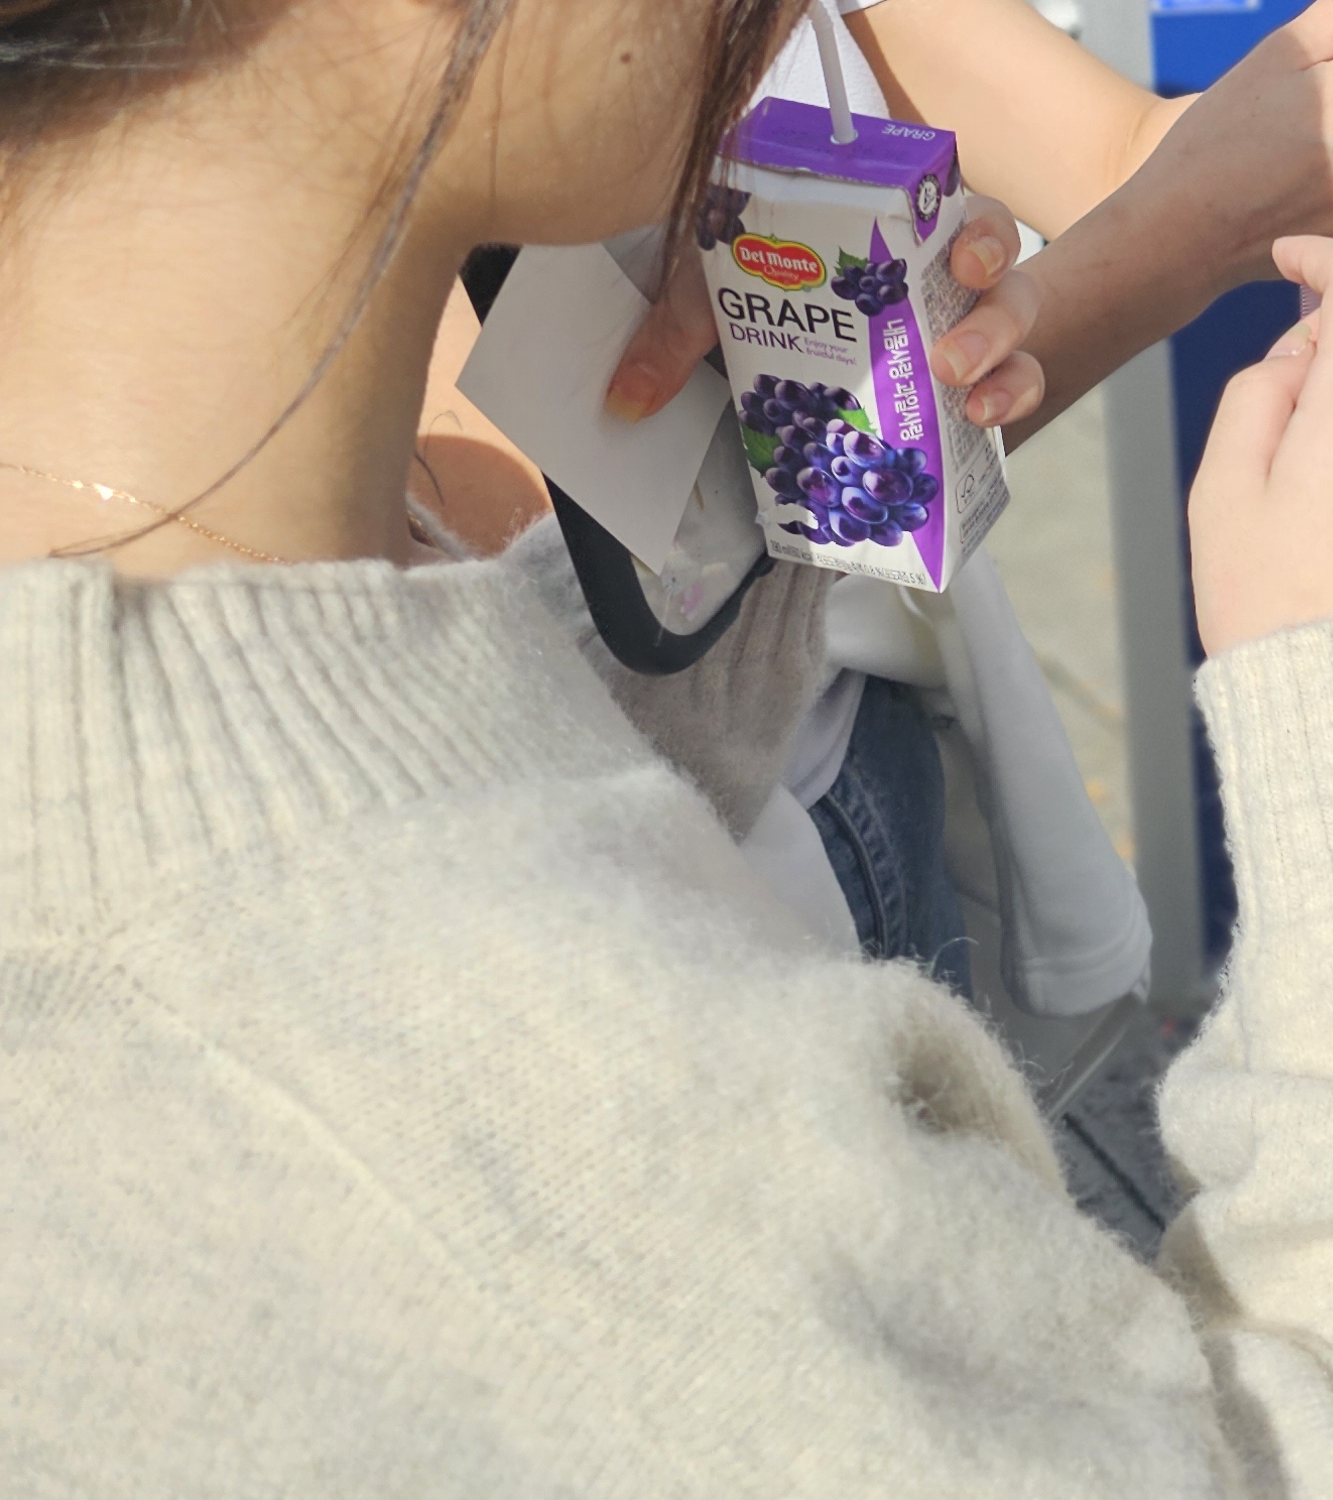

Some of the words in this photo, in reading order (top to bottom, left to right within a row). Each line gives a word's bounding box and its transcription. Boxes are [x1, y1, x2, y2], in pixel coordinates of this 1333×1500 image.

[882, 122, 936, 141] GRAPE
[739, 246, 765, 264] Del
[766, 251, 818, 273] Monte
[717, 287, 857, 343] GRAPE
[729, 322, 804, 353] DRINK
[804, 337, 828, 350] Enjoy
[883, 318, 914, 380] 내몸사랑
[893, 380, 924, 441] 과일사랑
